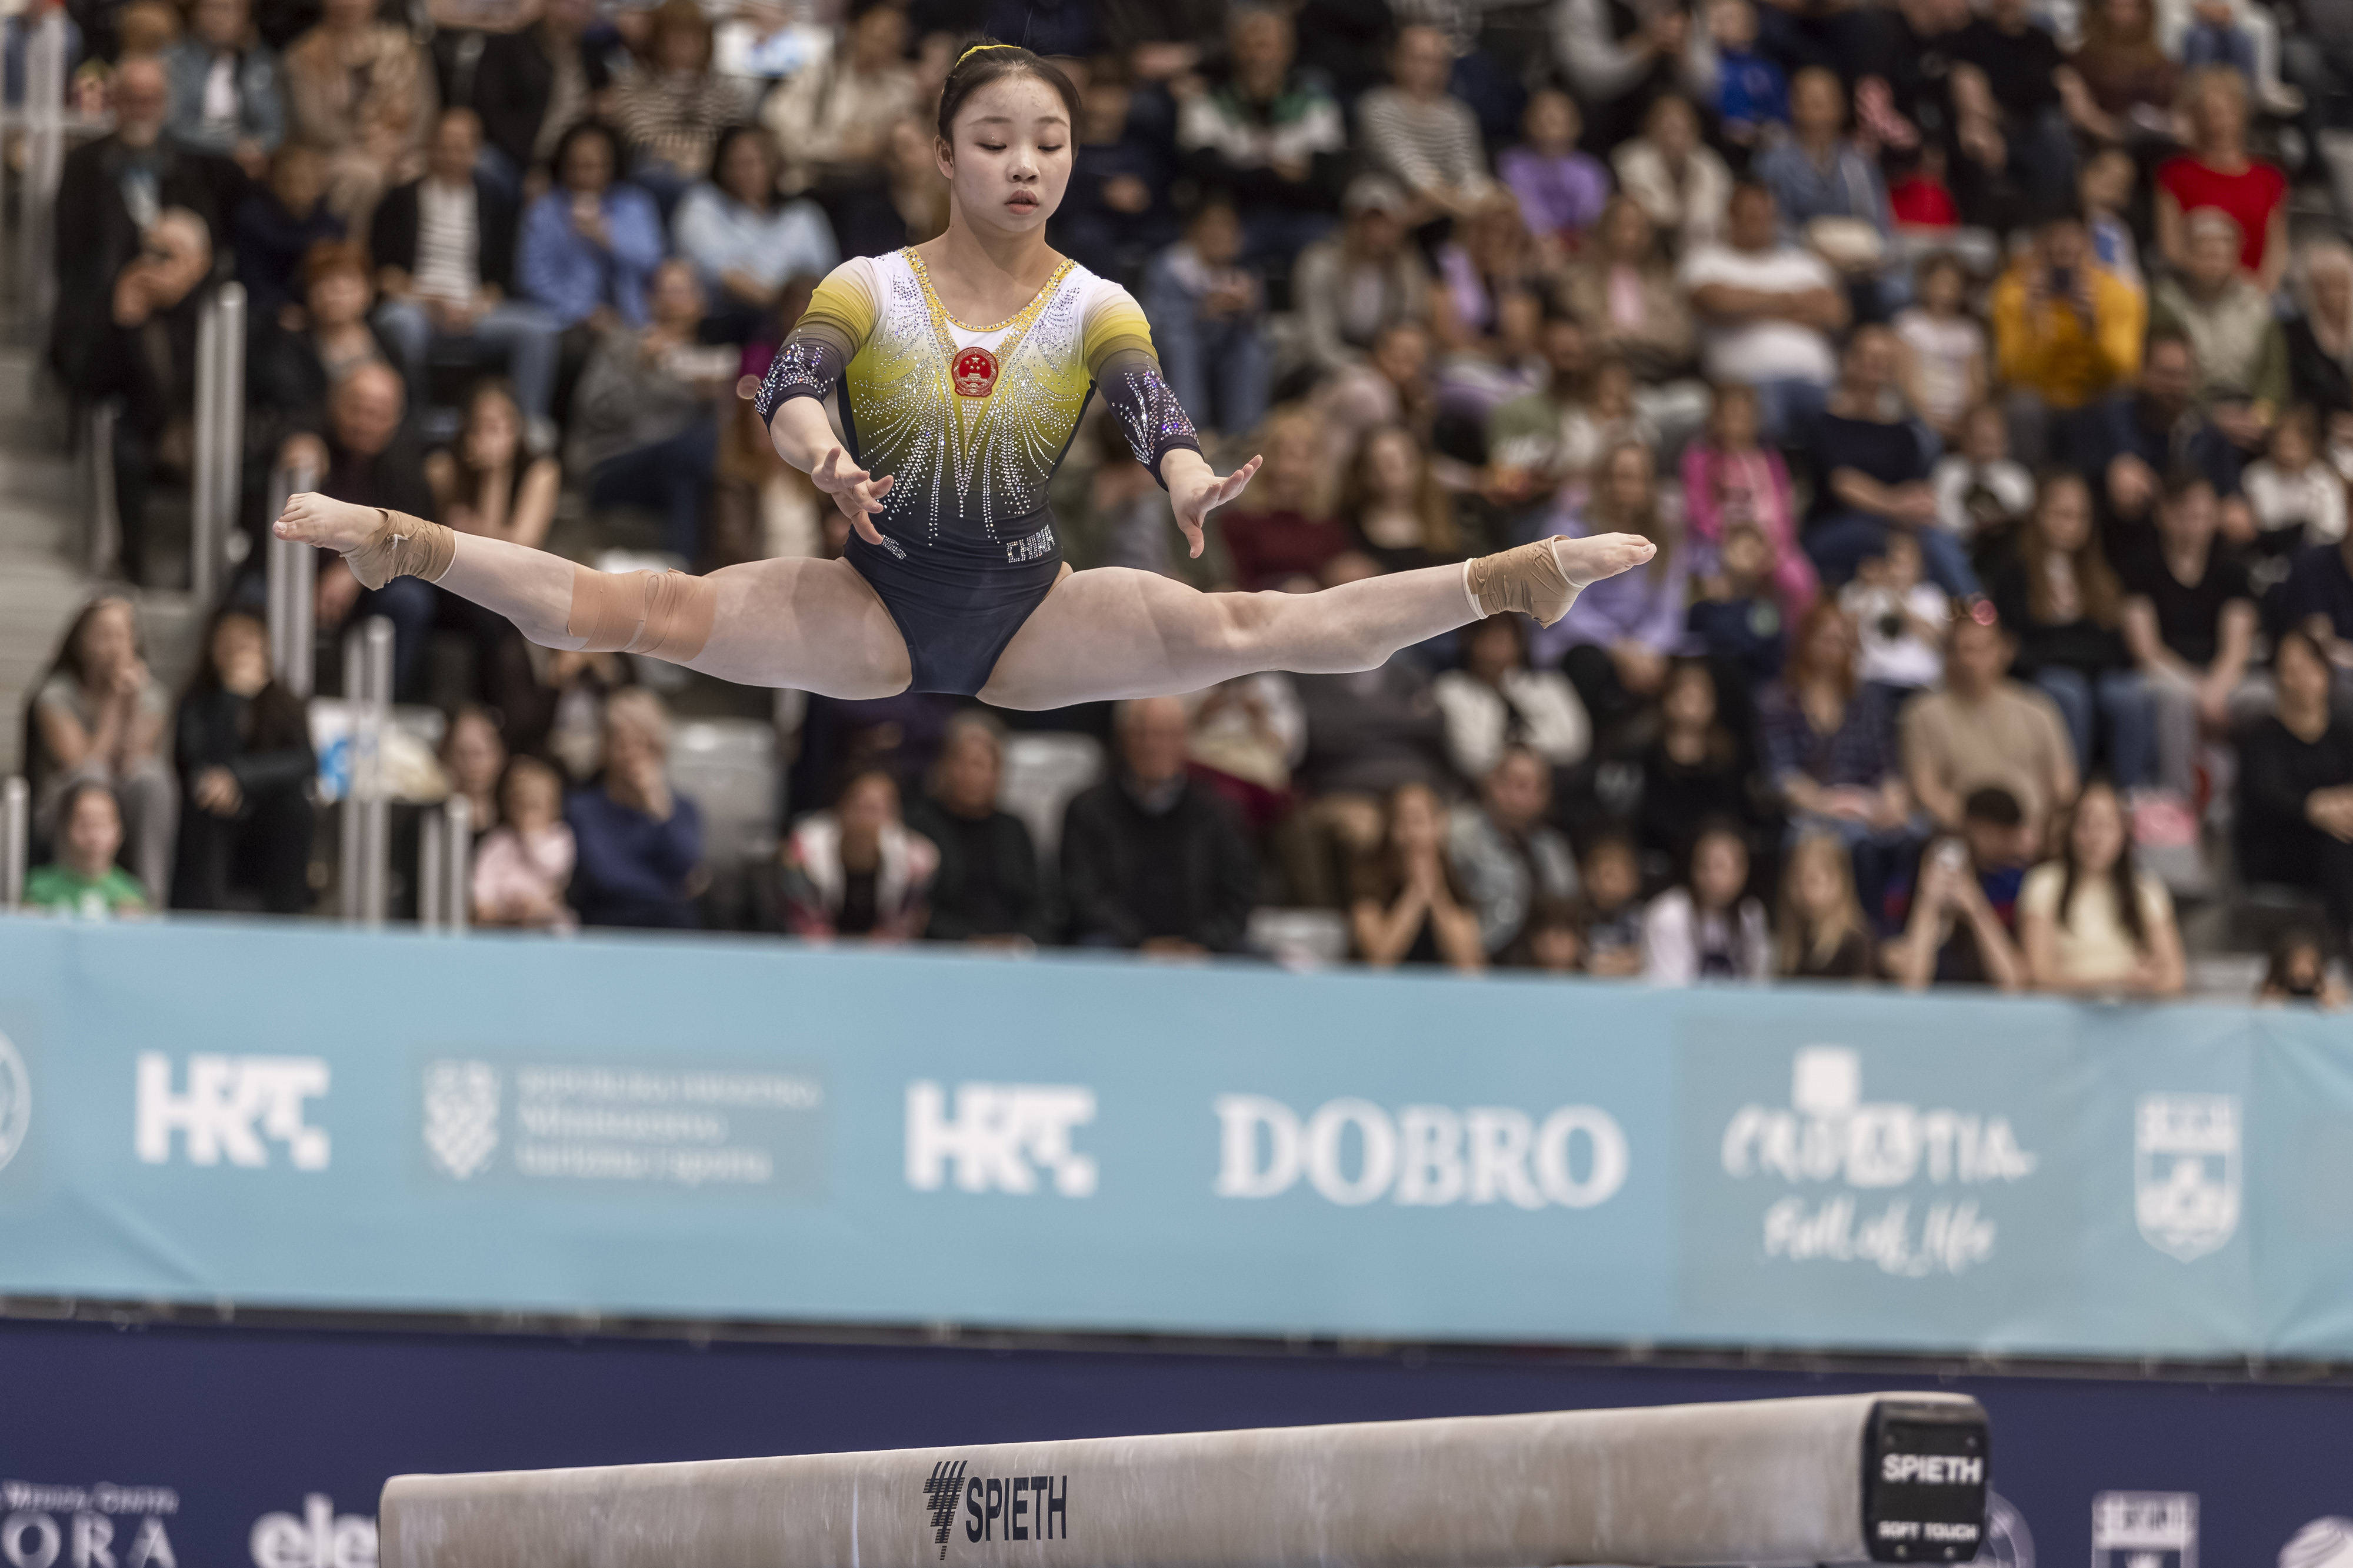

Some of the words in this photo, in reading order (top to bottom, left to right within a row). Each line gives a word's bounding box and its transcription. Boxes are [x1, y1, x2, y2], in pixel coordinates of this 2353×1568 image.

[1006, 524, 1055, 563] CHINA
[1212, 1091, 1631, 1212] DOBRO
[1882, 1453, 1984, 1486] SPIETH
[965, 1475, 1068, 1543] SPIETH
[1879, 1520, 1919, 1539] SOFT
[1923, 1522, 1978, 1542] TOUCH
